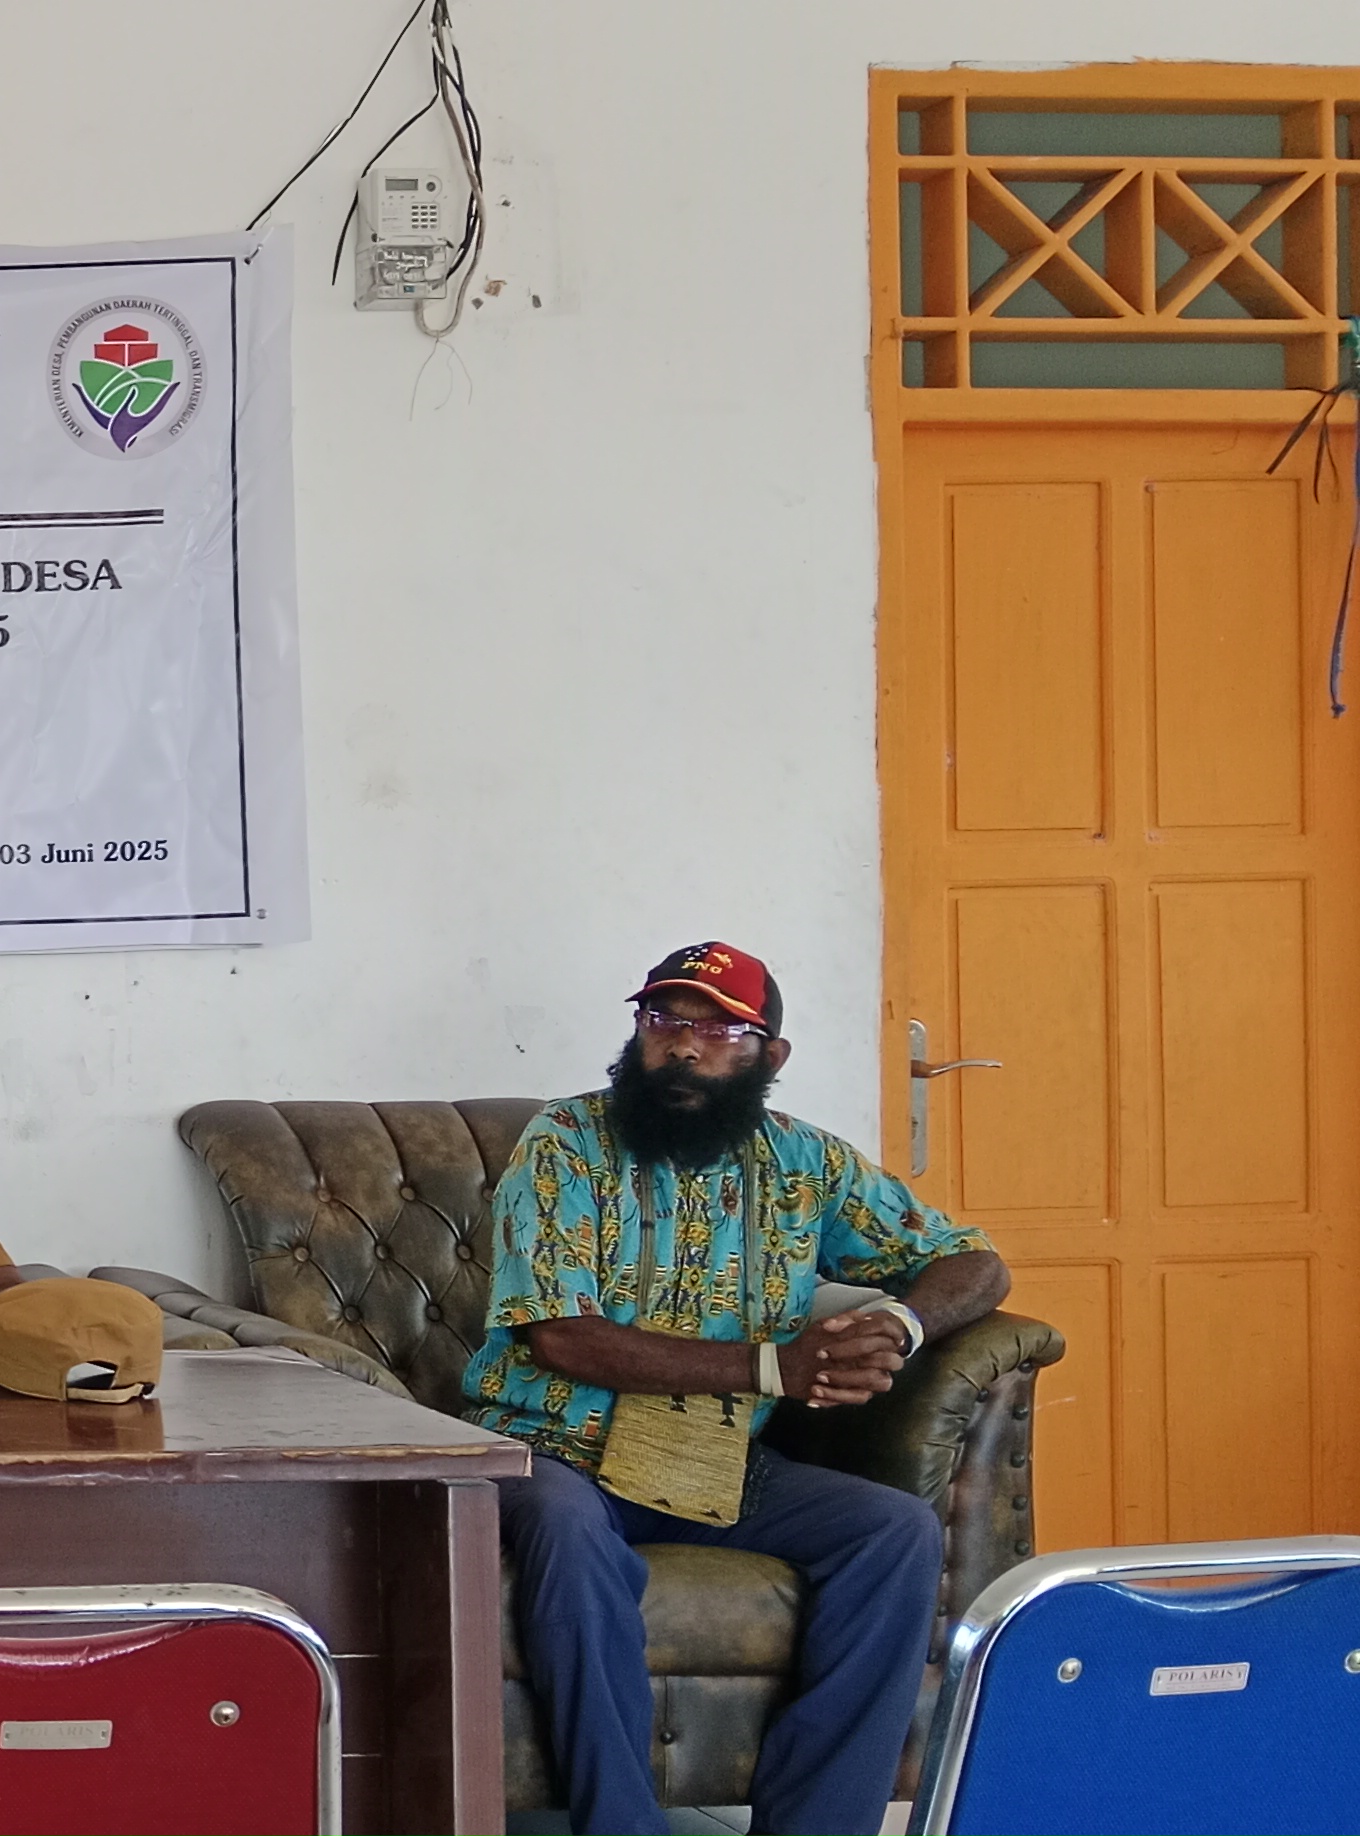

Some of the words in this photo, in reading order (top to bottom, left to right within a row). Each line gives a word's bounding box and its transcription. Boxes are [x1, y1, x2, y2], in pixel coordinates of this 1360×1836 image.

[57, 303, 112, 349] PEMBANGUNAN
[113, 299, 152, 310] DAERAH
[169, 371, 203, 436] TRANSMIGRASI
[1, 557, 122, 593] DESA
[41, 842, 95, 865] Juni
[103, 840, 169, 863] 2025
